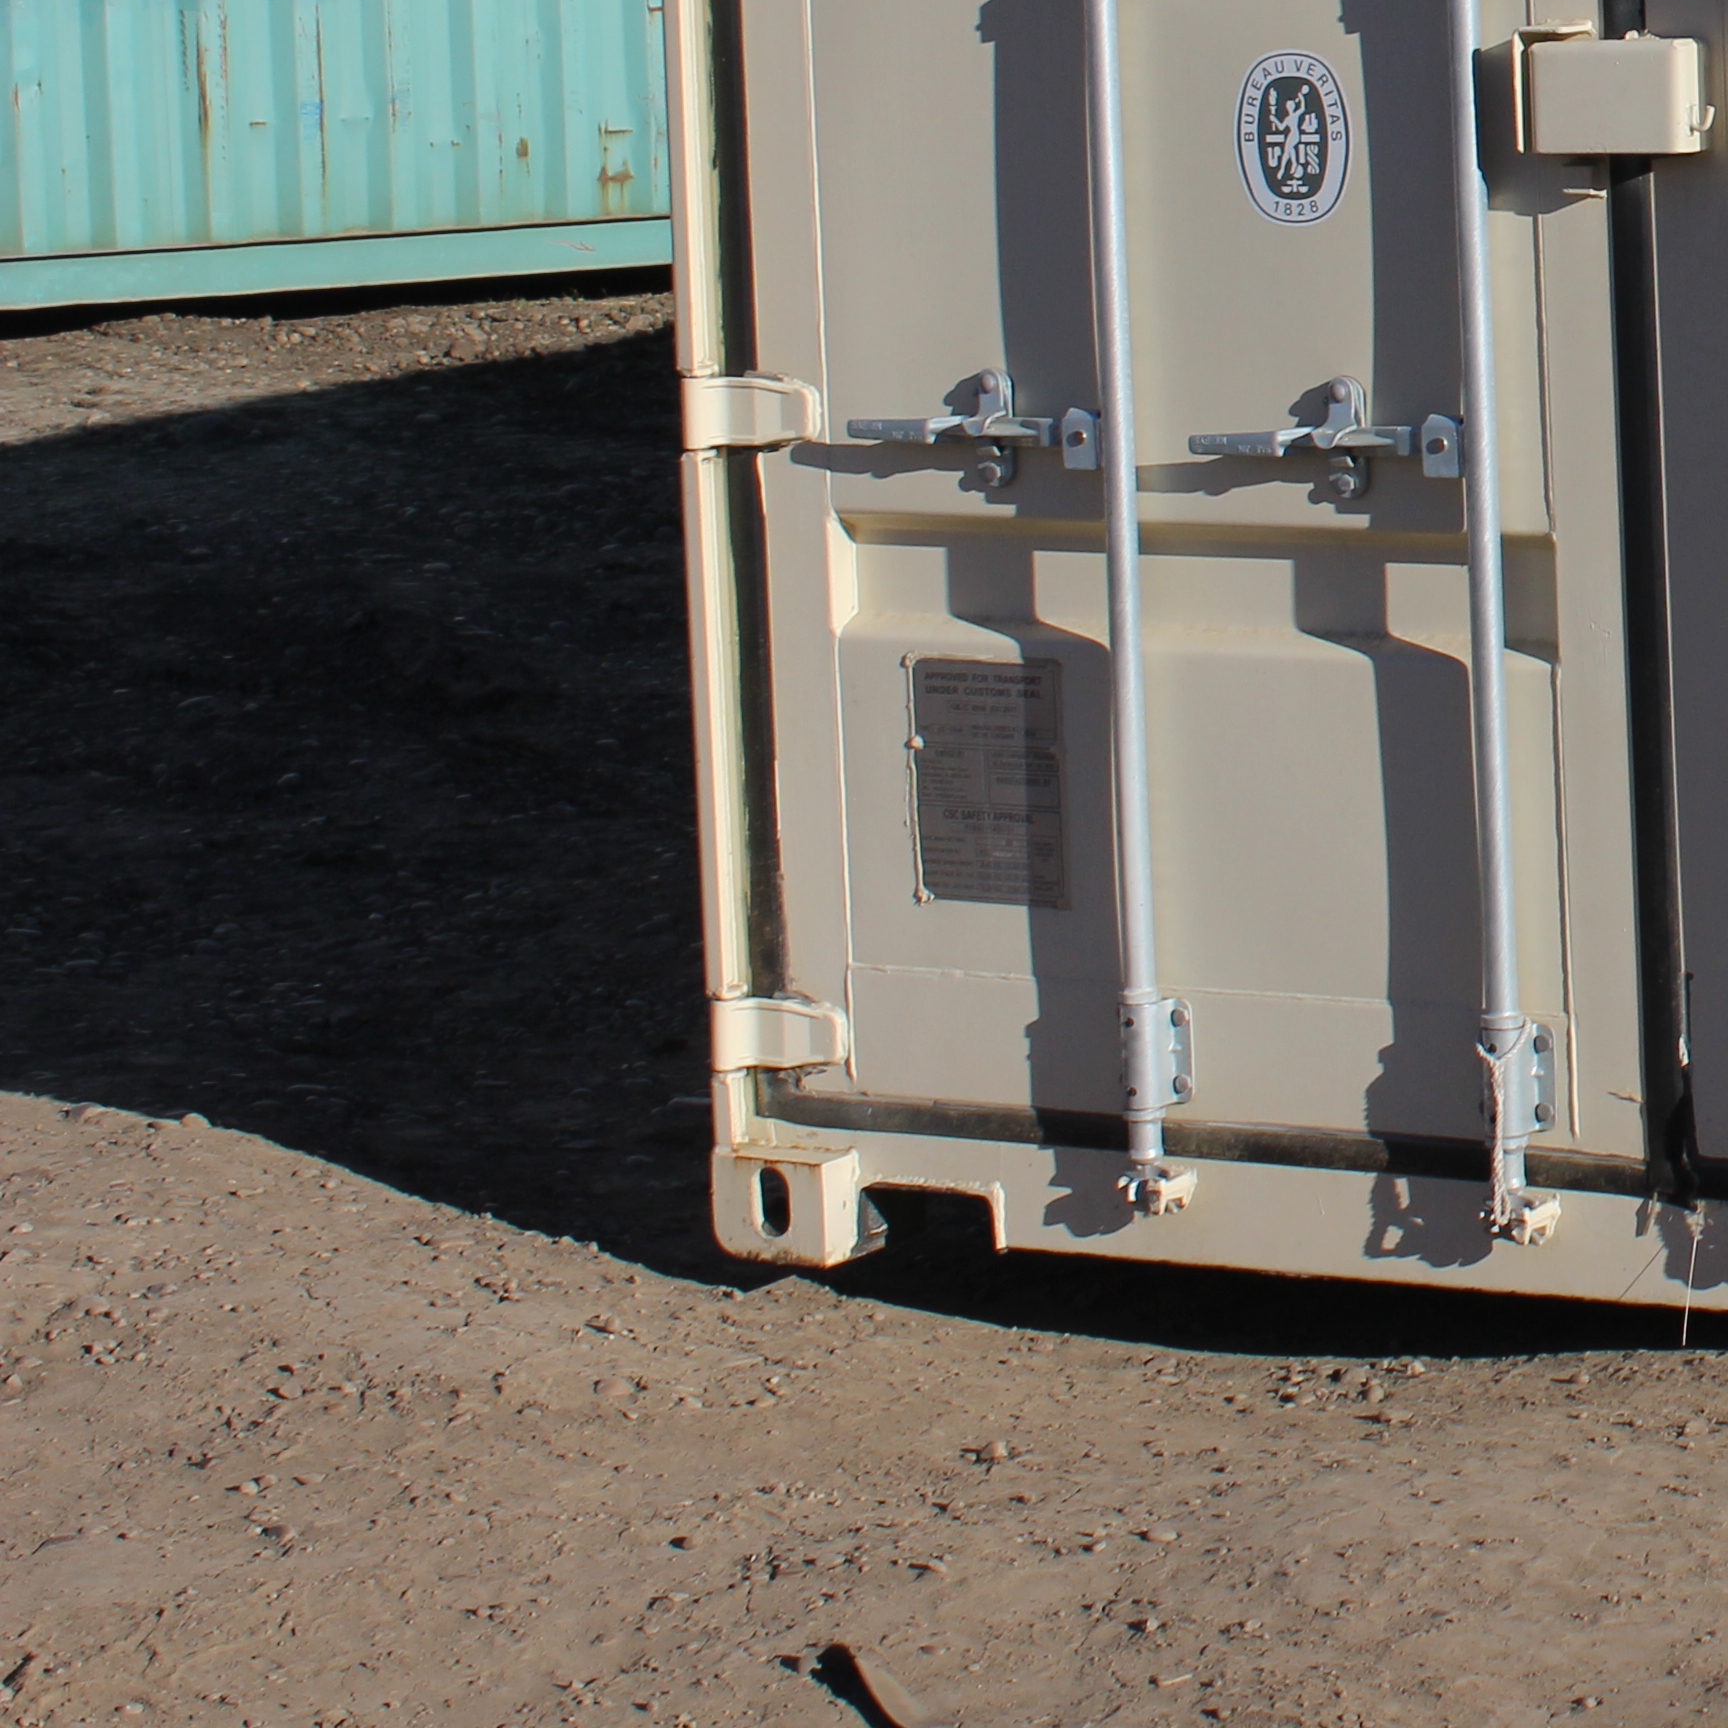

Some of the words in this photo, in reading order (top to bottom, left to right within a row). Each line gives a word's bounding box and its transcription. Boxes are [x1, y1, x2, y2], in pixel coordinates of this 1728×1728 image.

[1243, 59, 1285, 143] BUREAU
[1293, 58, 1343, 142] VERITAS
[1272, 199, 1320, 217] 1828
